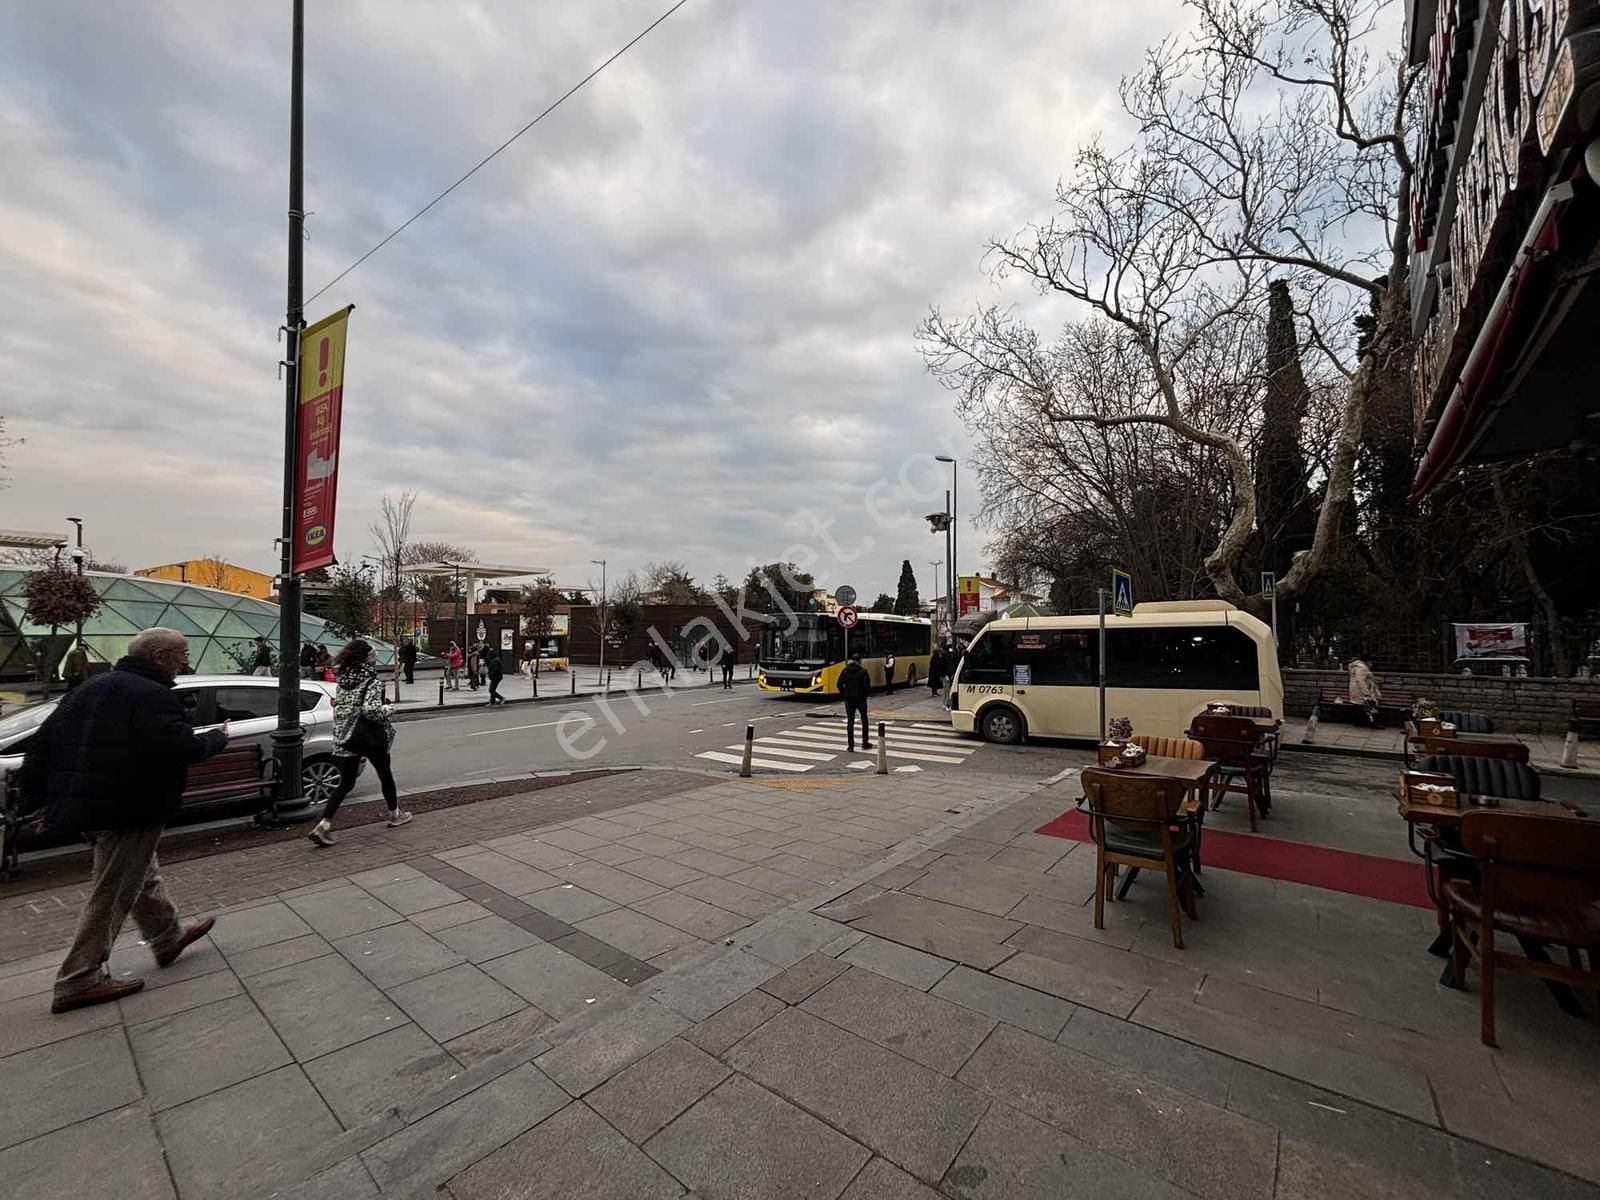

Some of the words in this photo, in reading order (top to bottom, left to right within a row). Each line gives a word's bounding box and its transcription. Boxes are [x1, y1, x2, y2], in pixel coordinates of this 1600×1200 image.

[307, 529, 324, 542] IKEA
[966, 685, 976, 694] M
[979, 685, 1004, 695] 0763
